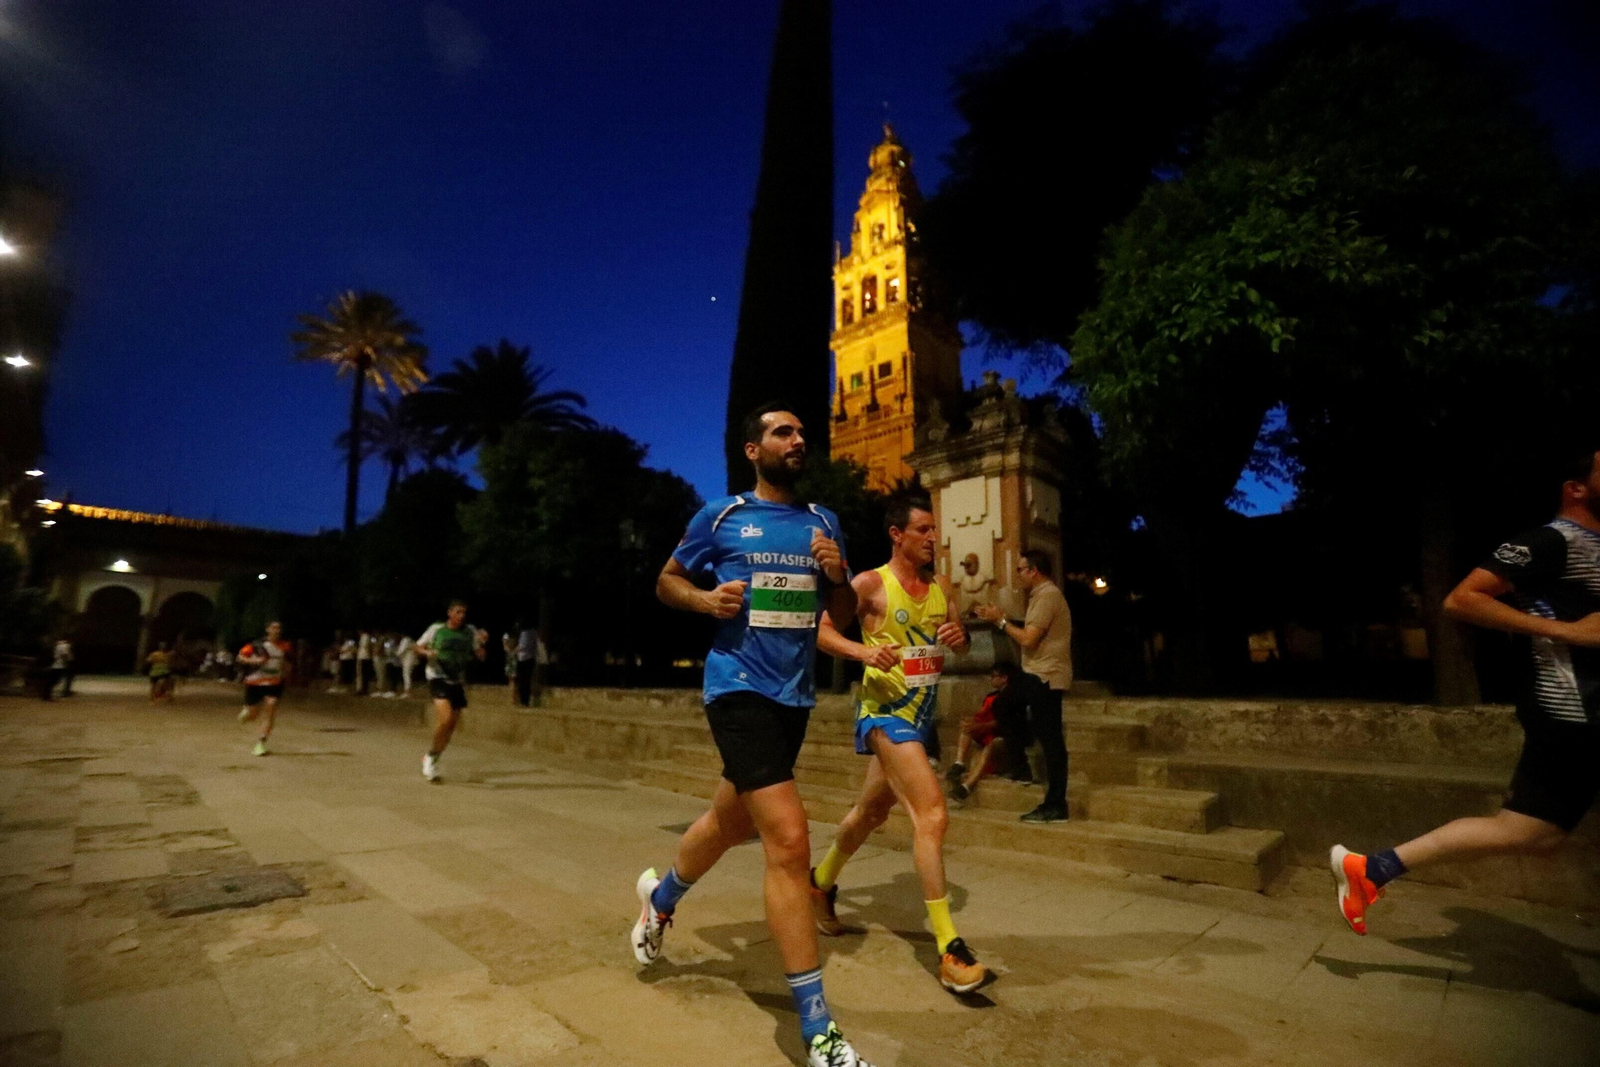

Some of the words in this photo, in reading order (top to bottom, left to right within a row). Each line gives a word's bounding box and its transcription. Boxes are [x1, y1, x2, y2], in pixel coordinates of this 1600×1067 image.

[773, 576, 788, 588] 20
[772, 591, 803, 607] 406
[917, 648, 927, 657] 20
